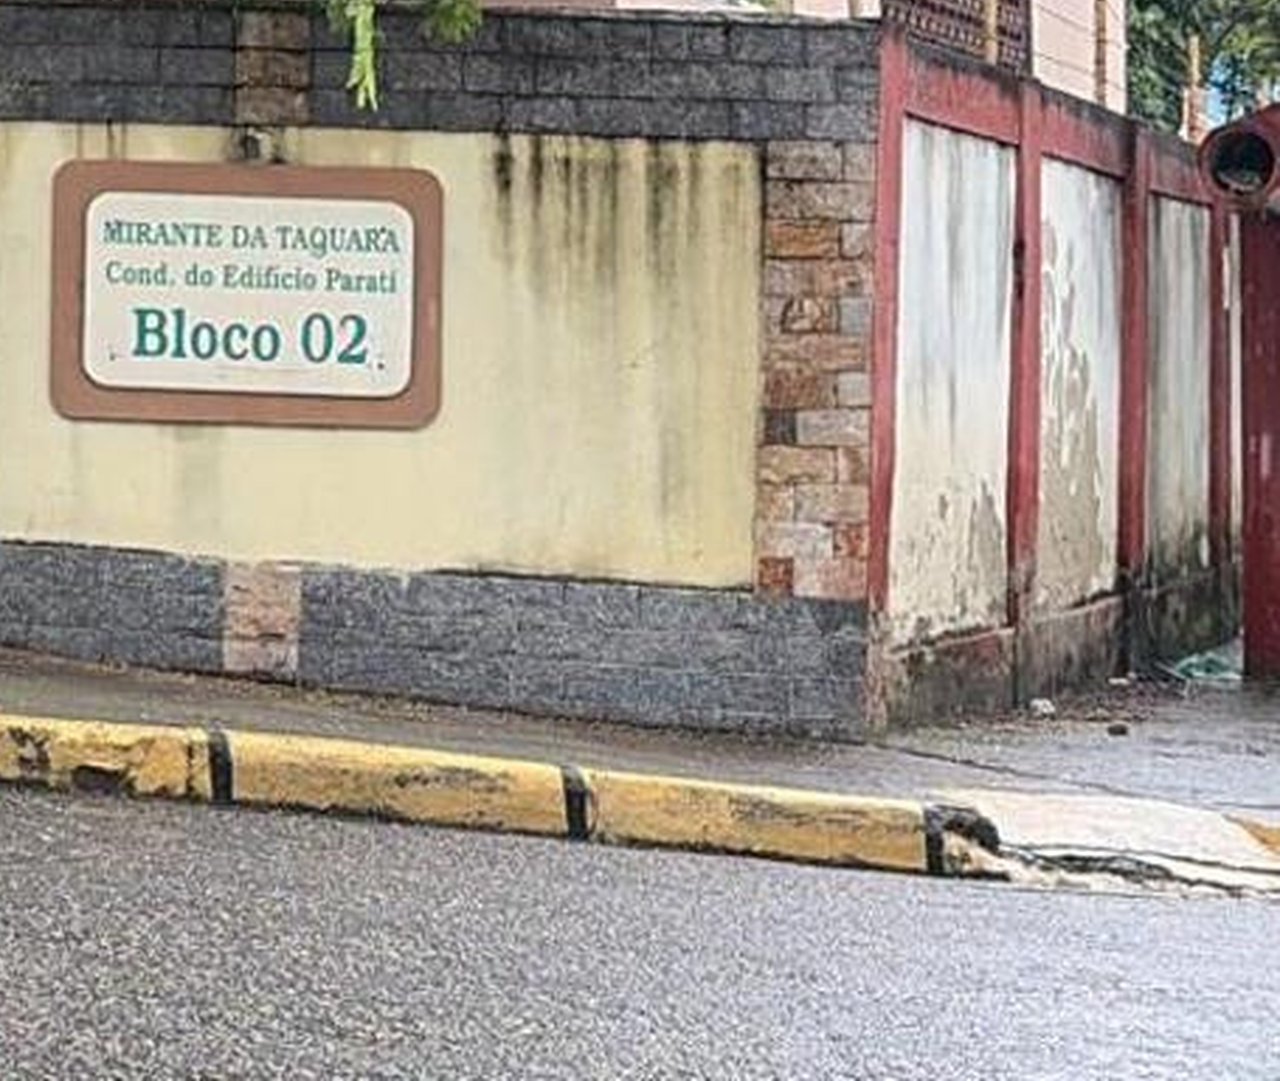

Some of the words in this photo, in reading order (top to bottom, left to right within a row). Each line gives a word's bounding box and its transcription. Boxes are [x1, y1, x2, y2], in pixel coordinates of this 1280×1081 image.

[102, 220, 224, 249] MIRANTE
[231, 226, 269, 250] DA
[274, 226, 401, 259] TAQUARA
[105, 260, 176, 287] Cond.
[184, 263, 215, 288] do
[131, 307, 282, 362] Bloco
[300, 312, 369, 365] 02
